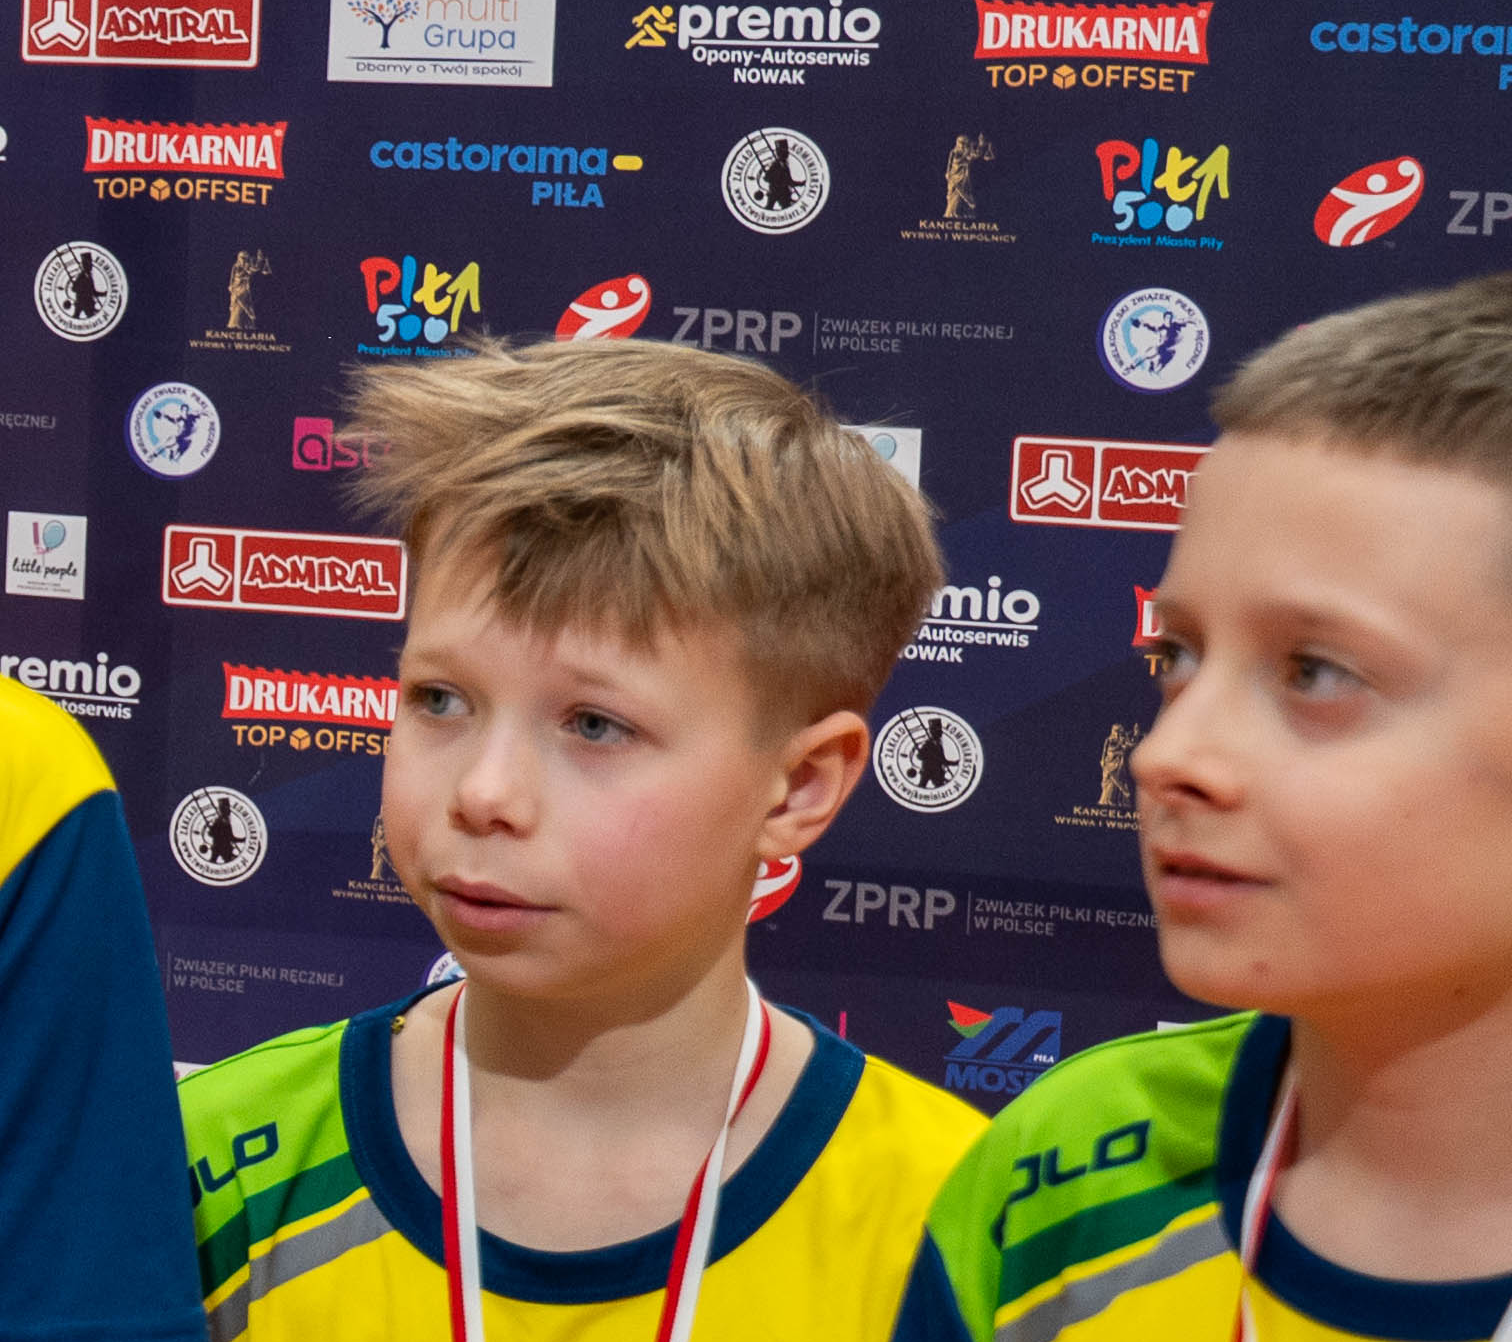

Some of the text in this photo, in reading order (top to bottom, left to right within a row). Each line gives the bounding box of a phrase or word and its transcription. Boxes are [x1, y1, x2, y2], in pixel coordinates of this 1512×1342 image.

[98, 5, 249, 45] ADMIRAL
[424, 24, 516, 54] Grupa
[983, 11, 1200, 54] DRUKARNIA
[1310, 16, 1512, 55] castora
[356, 61, 410, 74] Dbamy
[432, 63, 468, 77] Twój
[473, 64, 522, 78] spokój
[692, 46, 870, 66] Opony-Autoserwis
[734, 68, 805, 84] NOWAK
[985, 65, 1194, 92] TOP OFFSET
[91, 129, 276, 170] DRUKARNIA
[370, 137, 607, 176] castorama
[94, 178, 272, 205] TOP OFFSET
[532, 181, 604, 208] PIŁA
[919, 219, 999, 232] KANCELARIA
[1113, 190, 1194, 232] 500
[1446, 191, 1512, 236] ZP
[1156, 234, 1196, 248] Miasta
[376, 303, 448, 343] 500
[671, 307, 1014, 353] ZPRP ZWIĄZEK PIŁKI RĘCZNEJ
[821, 336, 901, 353] W POLSCE
[243, 553, 397, 596] ADMIRAL
[931, 575, 1040, 624] mio
[900, 645, 963, 663] OWAK
[229, 675, 398, 723] DRUKARNI
[232, 725, 392, 755] TOP OFFSE
[822, 879, 1159, 930] ZPRP ZWIĄZEK PIŁKI RĘCZNE
[974, 916, 1055, 936] W POLSCE
[173, 974, 245, 993] W POLSCE
